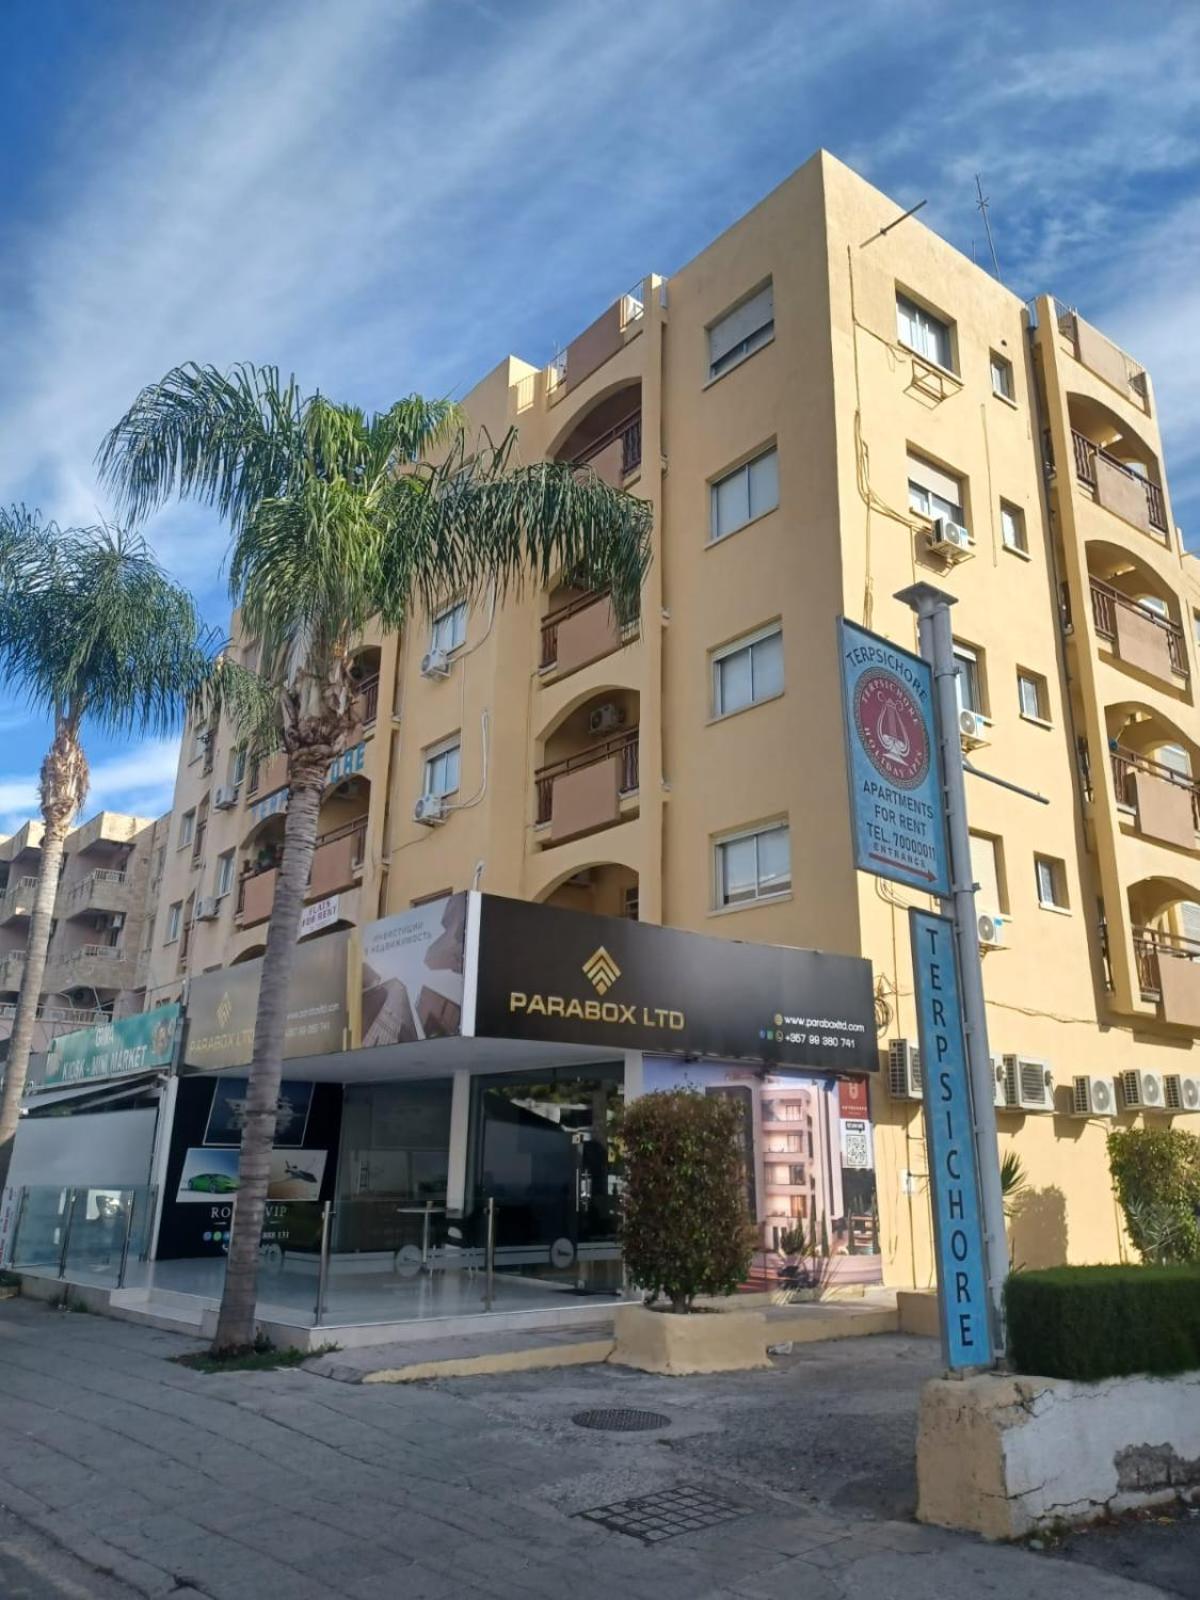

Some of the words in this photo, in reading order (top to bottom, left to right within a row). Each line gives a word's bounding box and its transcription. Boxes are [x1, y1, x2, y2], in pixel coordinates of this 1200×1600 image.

[845, 646, 928, 704] TERPSICHORE
[863, 779, 934, 819] APARTMENTS
[874, 804, 896, 825] FOR
[899, 814, 927, 837] RENT
[873, 842, 926, 868] ENTRANCE
[893, 832, 936, 859] 70000011
[509, 992, 636, 1024] PARABOX
[643, 1008, 685, 1031] LTD
[784, 1015, 865, 1033] www.paraboxltd.com
[785, 1032, 806, 1044] +357
[840, 1038, 856, 1049] 741
[110, 1045, 148, 1073] MARKET
[926, 927, 974, 1348] TERPSICHORE
